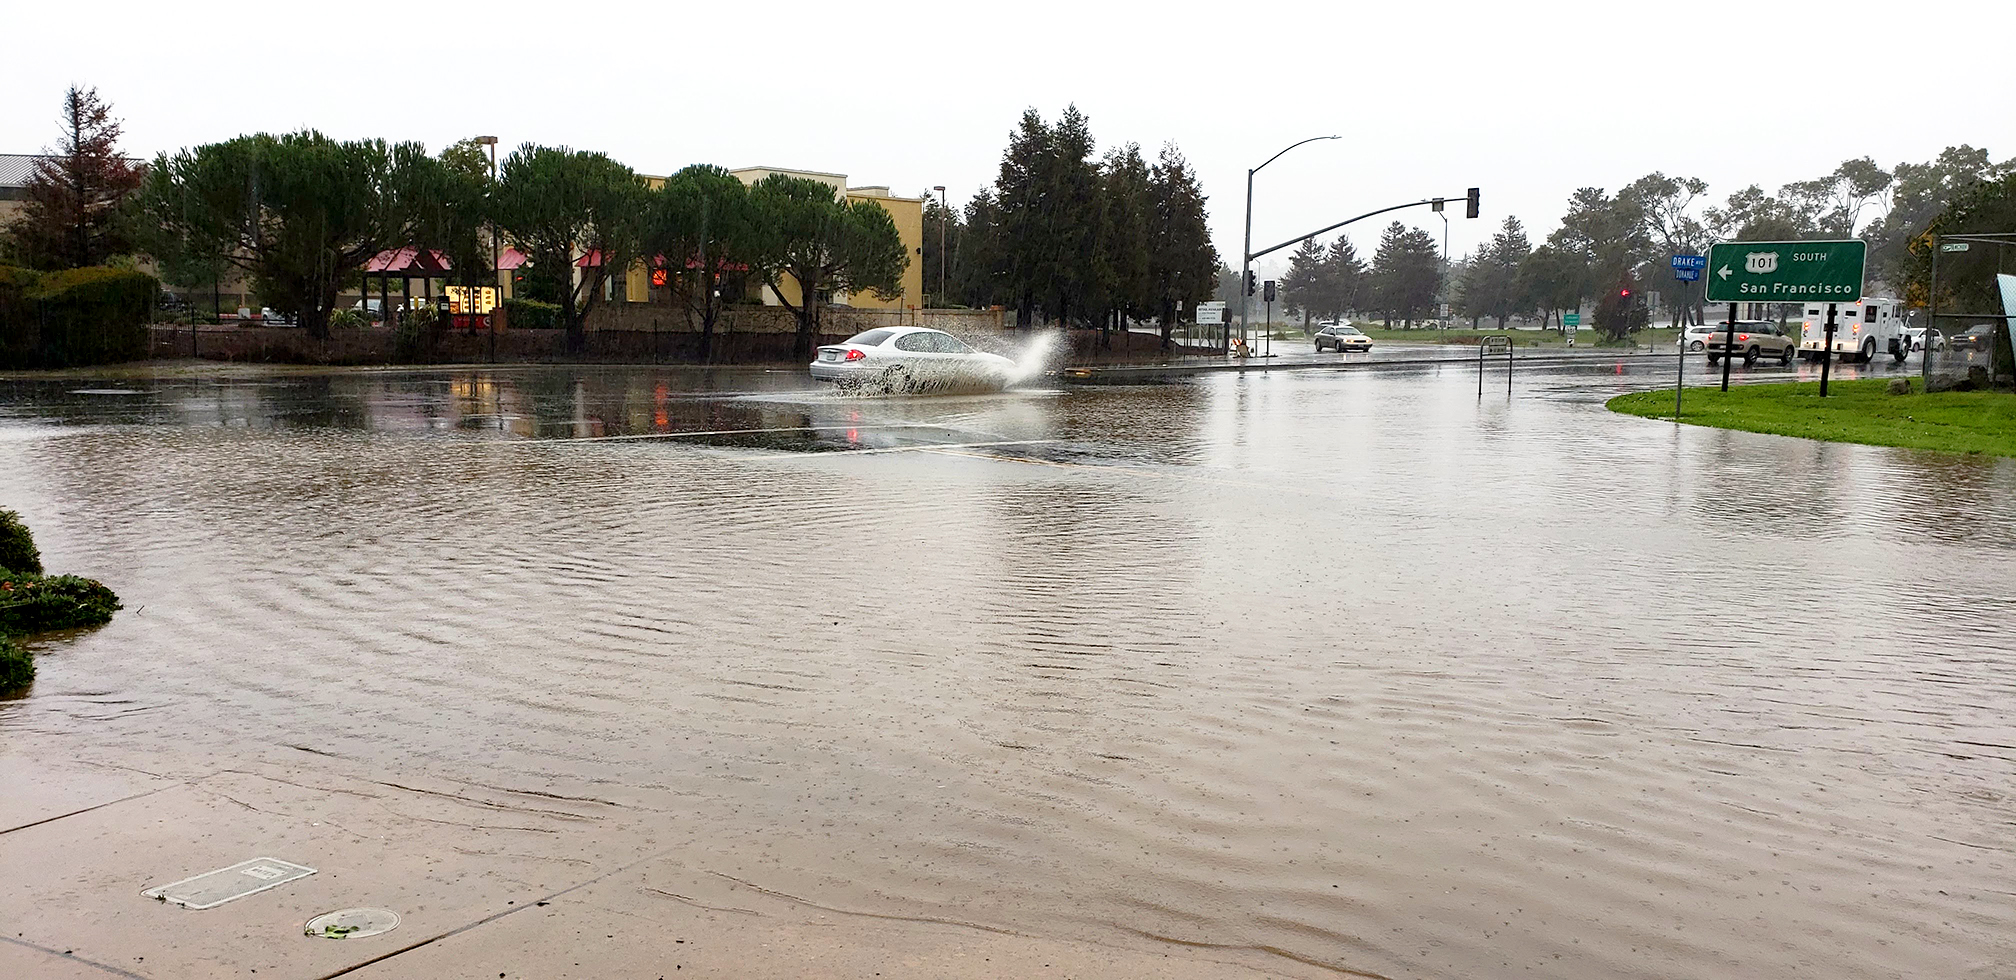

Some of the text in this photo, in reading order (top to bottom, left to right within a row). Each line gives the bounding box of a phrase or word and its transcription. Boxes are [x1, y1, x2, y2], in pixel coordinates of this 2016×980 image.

[1672, 256, 1695, 267] DRAKE
[1751, 257, 1773, 268] 101
[1793, 253, 1827, 262] SOUTH
[1740, 282, 1852, 294] San Francisco
